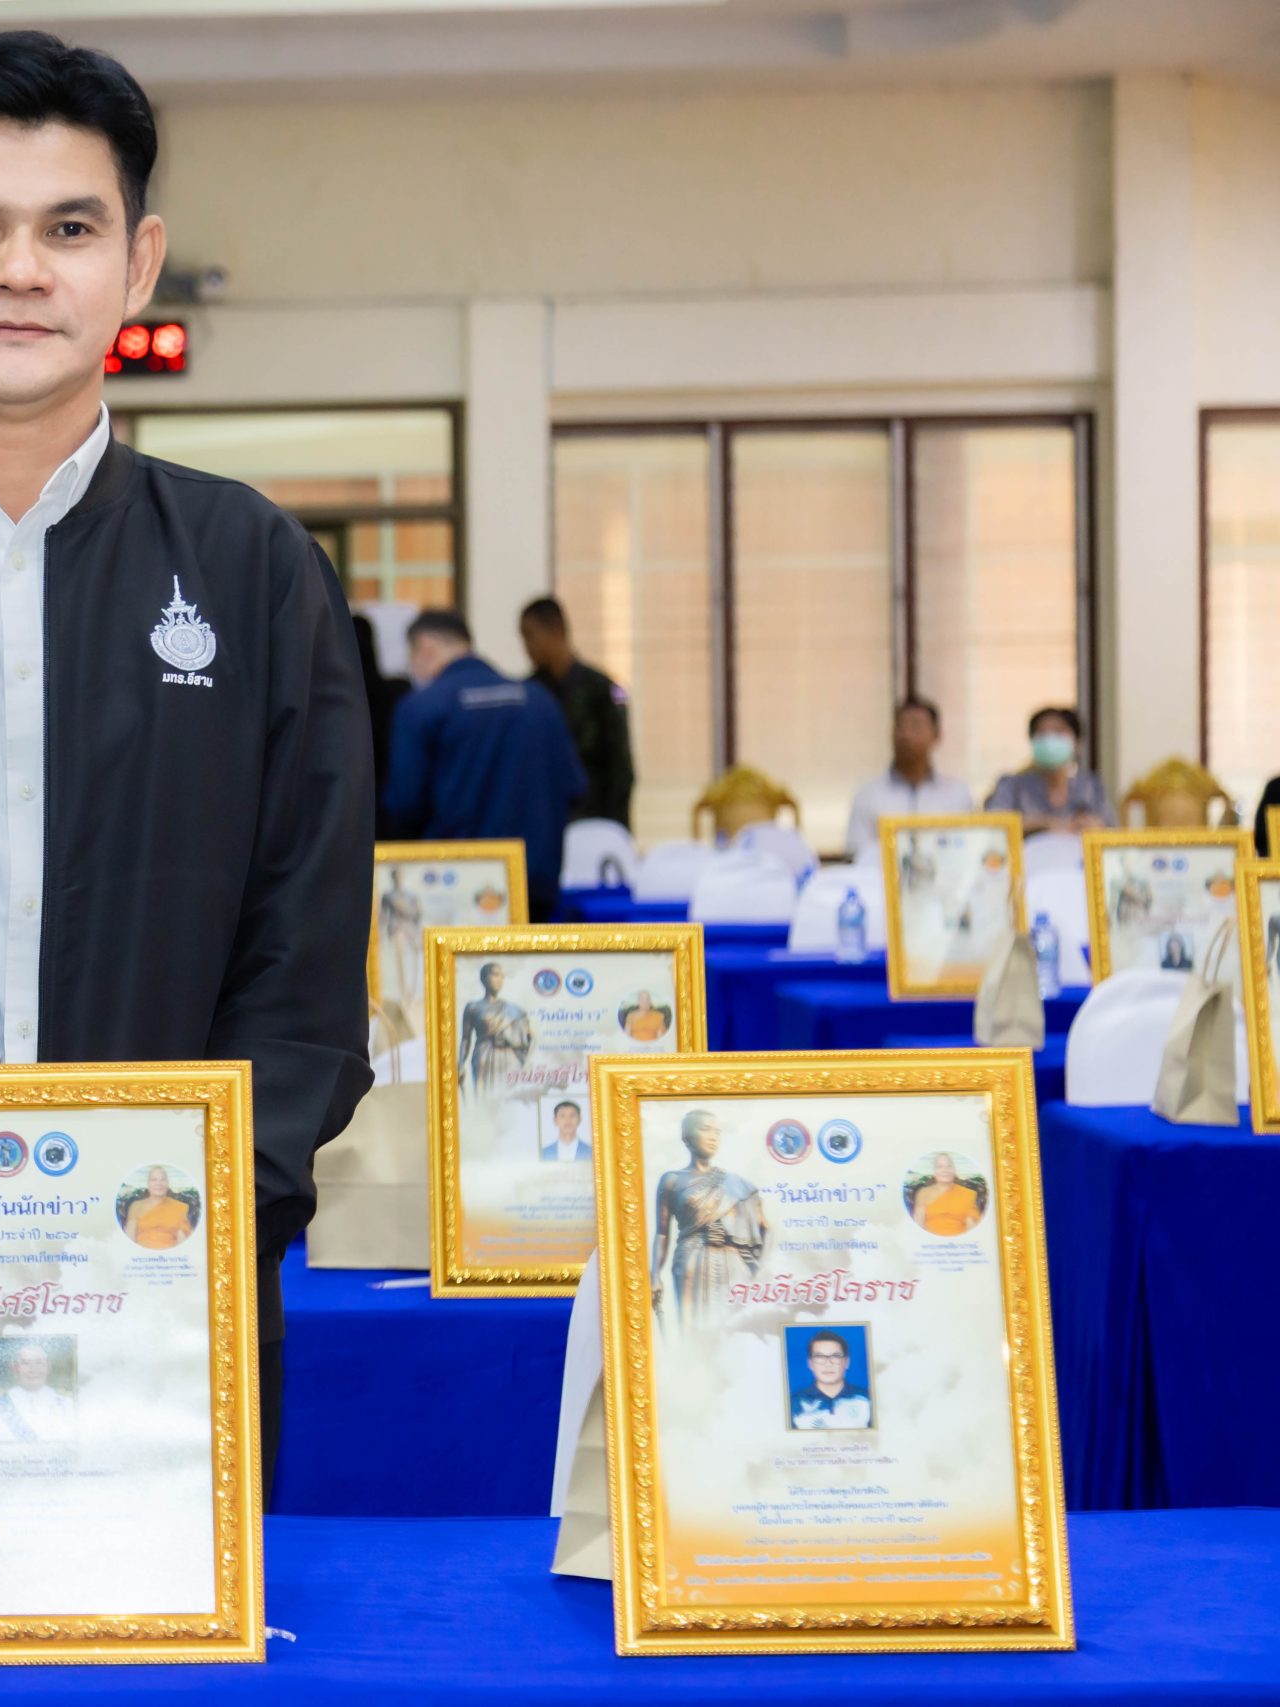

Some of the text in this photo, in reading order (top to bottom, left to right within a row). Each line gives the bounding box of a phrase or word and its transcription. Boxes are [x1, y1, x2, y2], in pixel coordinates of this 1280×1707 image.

[162, 672, 213, 687] มทร.อีสาน
[761, 1182, 887, 1203] “วันนักข่าว”
[729, 1268, 919, 1304] คนดีศรีโคราช
